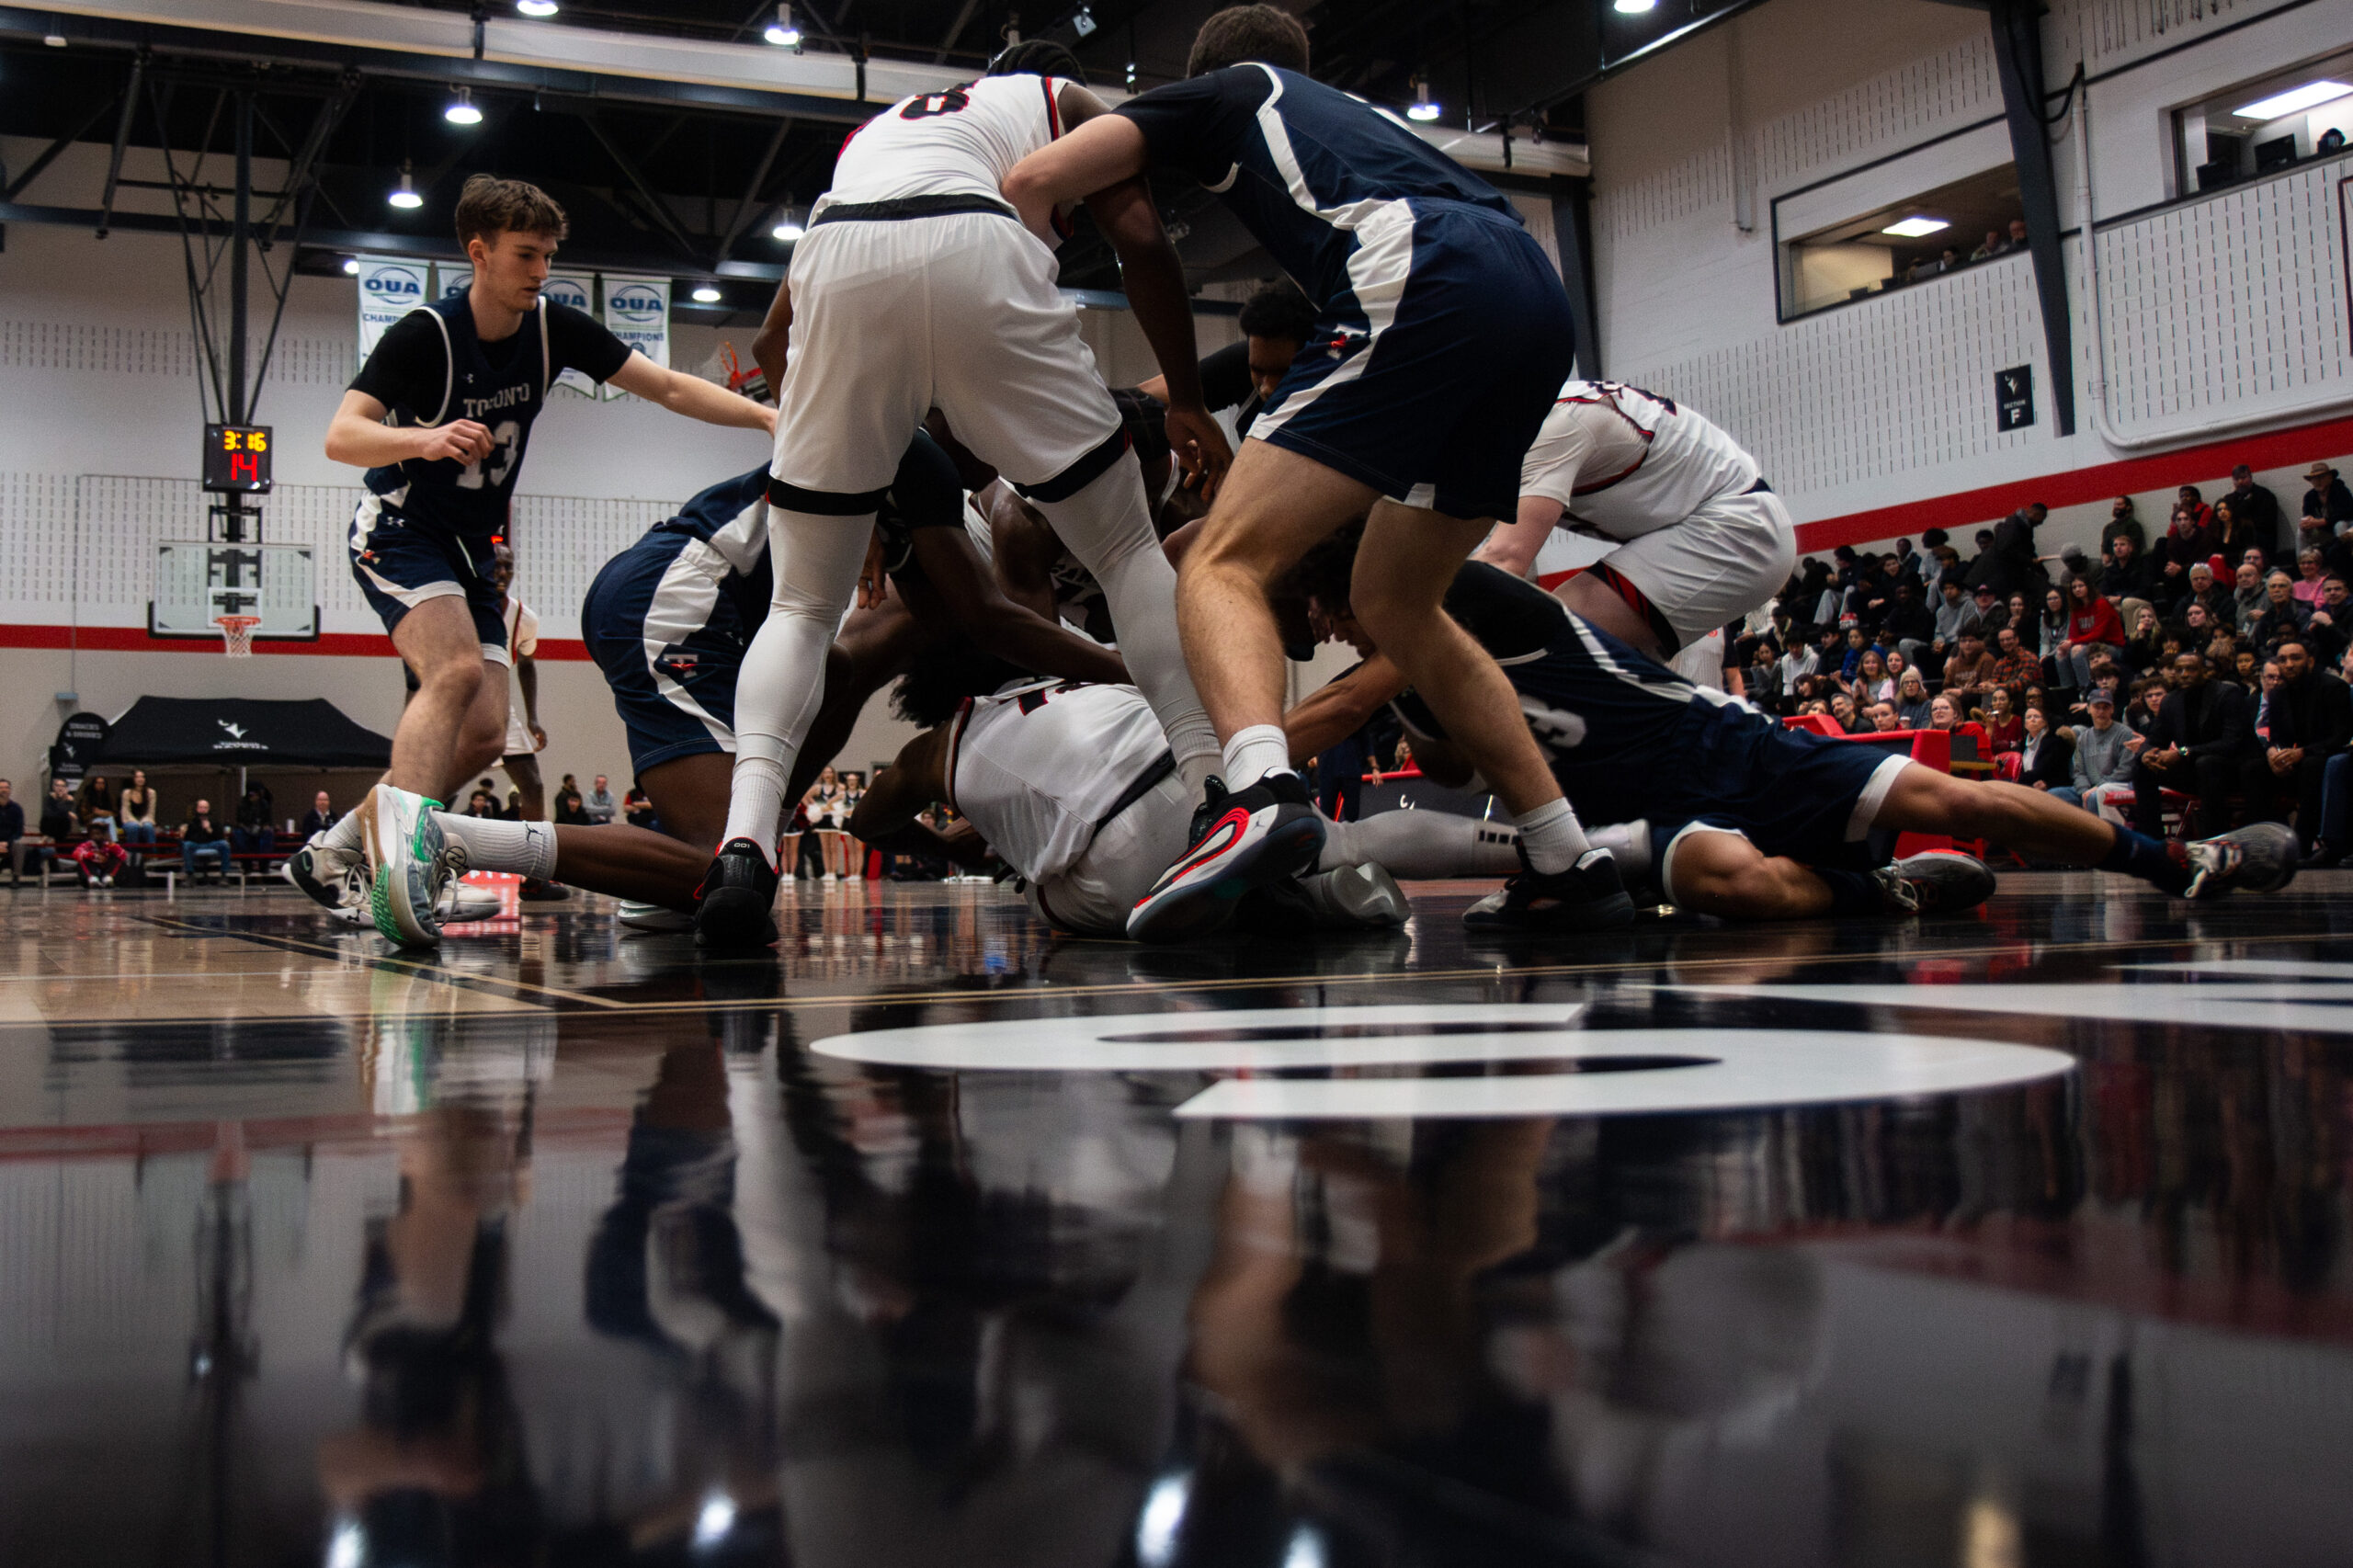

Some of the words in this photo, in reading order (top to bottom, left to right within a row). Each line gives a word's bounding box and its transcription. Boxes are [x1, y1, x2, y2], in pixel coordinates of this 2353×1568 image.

[365, 279, 420, 295] OUA
[610, 297, 663, 312] OUA
[613, 331, 664, 341] HAMPIONS
[463, 383, 529, 418] TOONO
[2011, 408, 2020, 424] F
[223, 430, 267, 452] 3:16
[231, 453, 257, 482] 14
